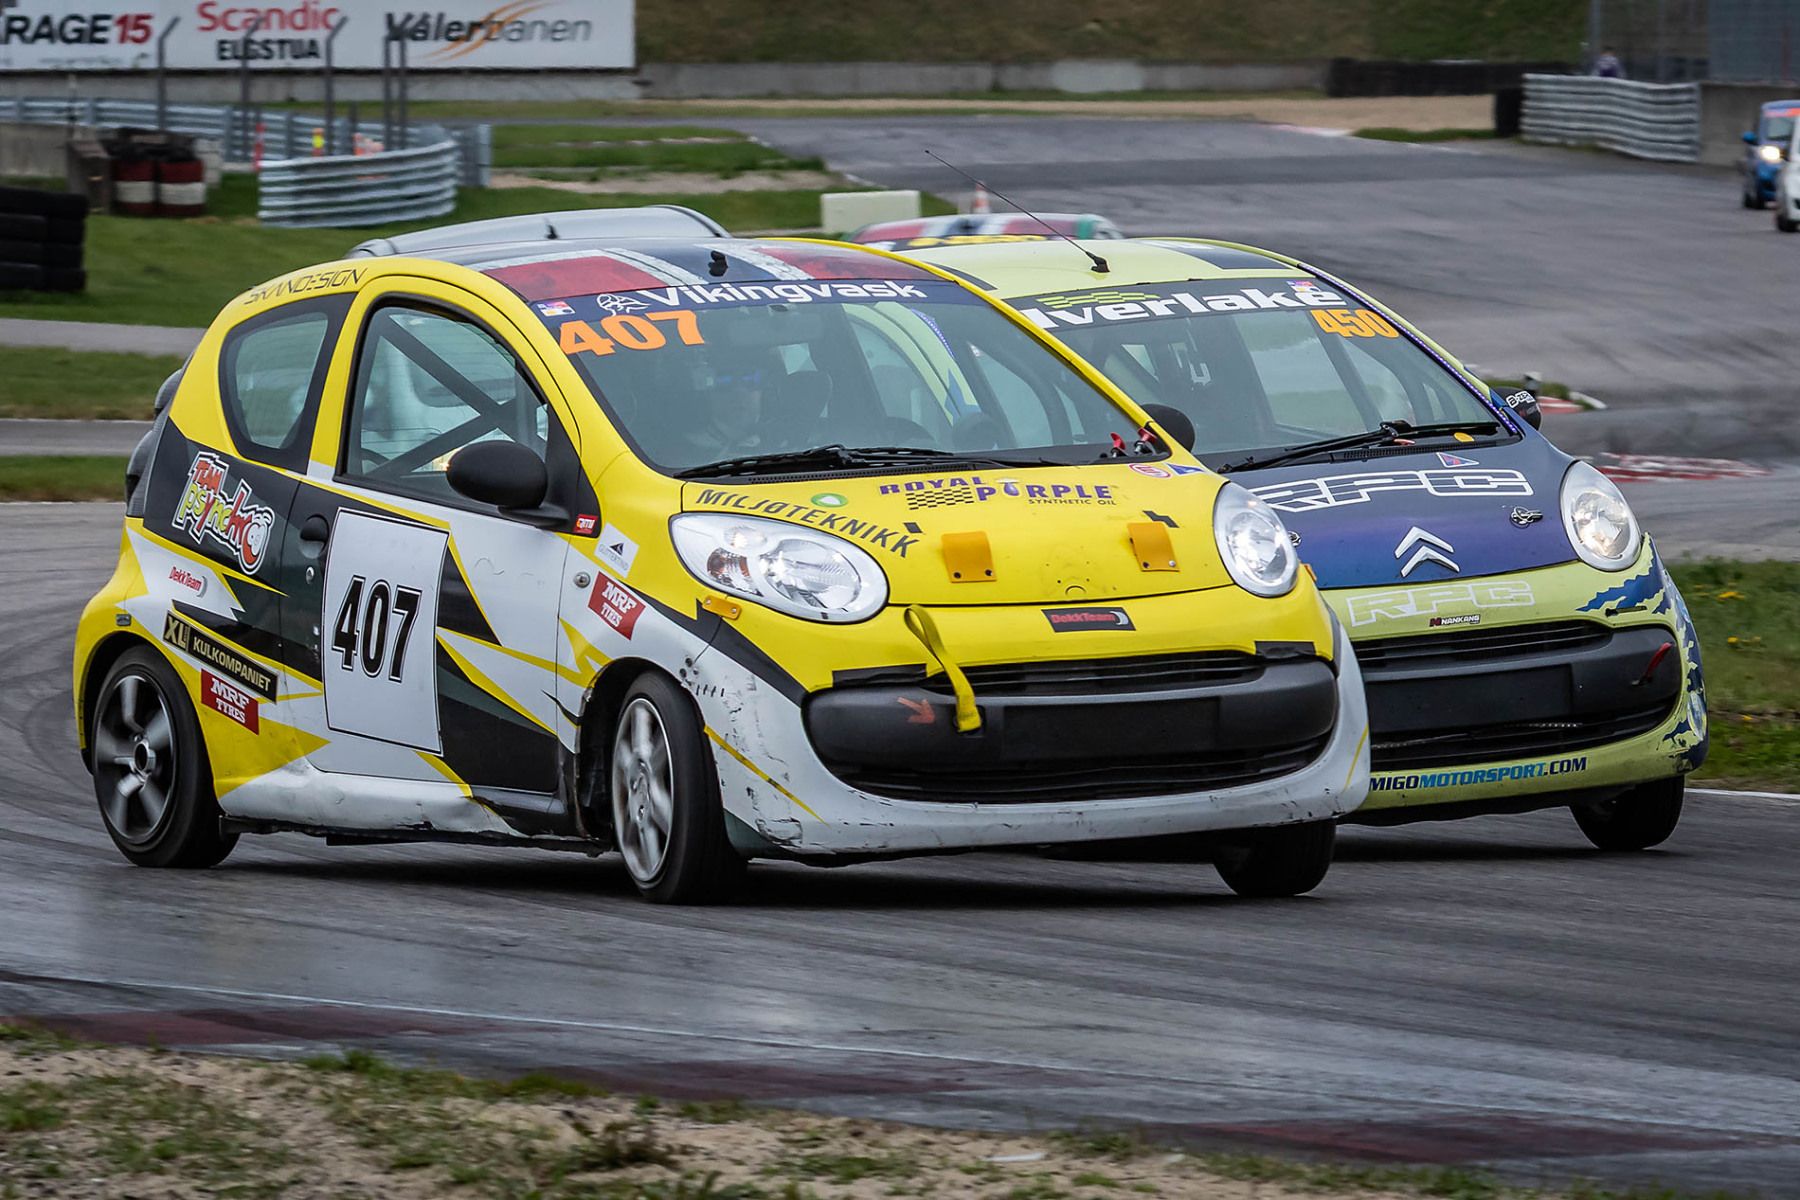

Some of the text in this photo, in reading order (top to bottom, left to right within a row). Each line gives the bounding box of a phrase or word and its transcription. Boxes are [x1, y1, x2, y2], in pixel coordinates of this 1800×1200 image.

[0, 13, 155, 45] RAGE15
[197, 1, 341, 32] Scandic
[643, 280, 928, 307] Vikingvask
[1019, 288, 1347, 329] lverlake
[559, 310, 705, 357] 407
[1310, 309, 1400, 339] 450
[880, 476, 987, 496] ROYAL
[602, 581, 637, 613] MRF
[332, 574, 422, 683] 407
[193, 636, 271, 692] KULKOMPANIET
[211, 677, 250, 709] MRF
[216, 698, 246, 724] TYRES
[1370, 757, 1587, 791] MIGOMOTORSPORT.COM
